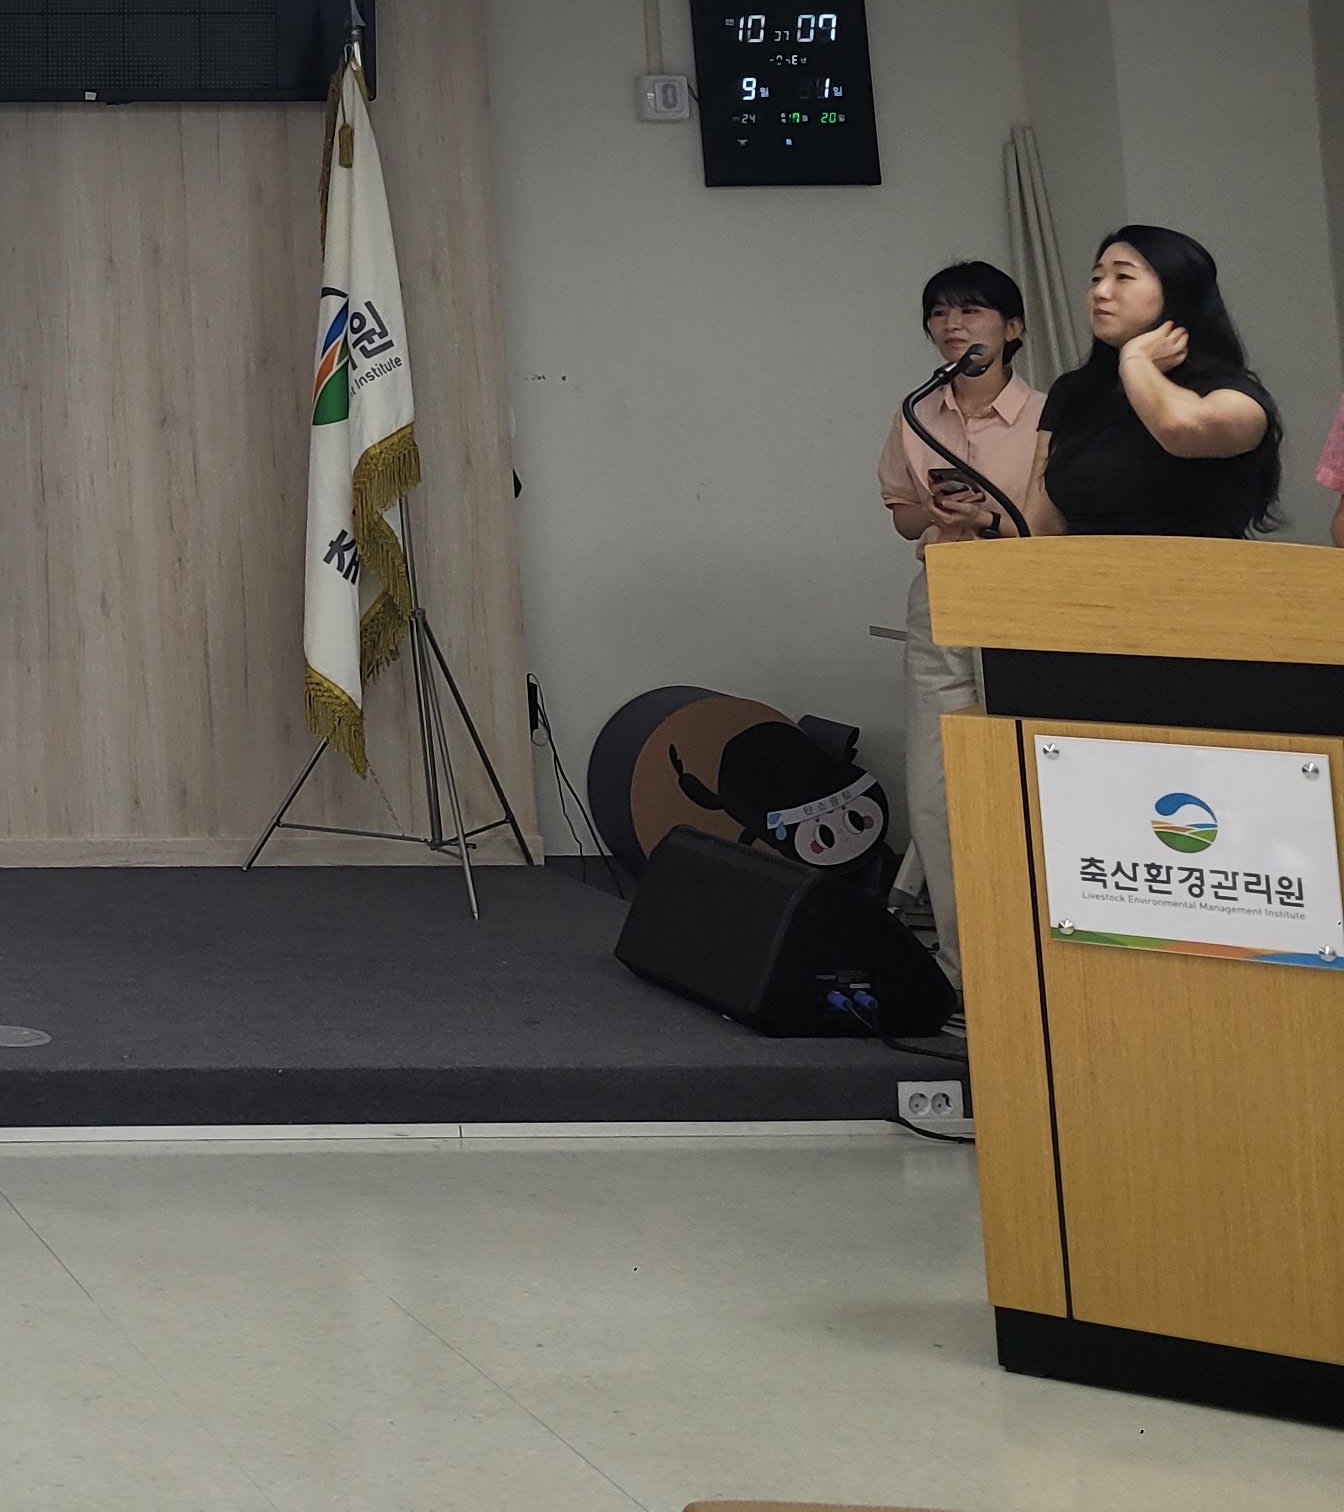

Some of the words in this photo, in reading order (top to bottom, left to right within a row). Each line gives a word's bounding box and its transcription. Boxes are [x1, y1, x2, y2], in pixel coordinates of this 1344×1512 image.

[738, 15, 766, 43] 10
[797, 14, 837, 42] 07
[353, 356, 403, 390] Institute
[1079, 857, 1305, 908] 축산환경관리원
[1082, 891, 1125, 903] Livestock
[1128, 895, 1197, 910] Environmental
[1199, 901, 1262, 916] Management
[1264, 908, 1306, 920] Institute
